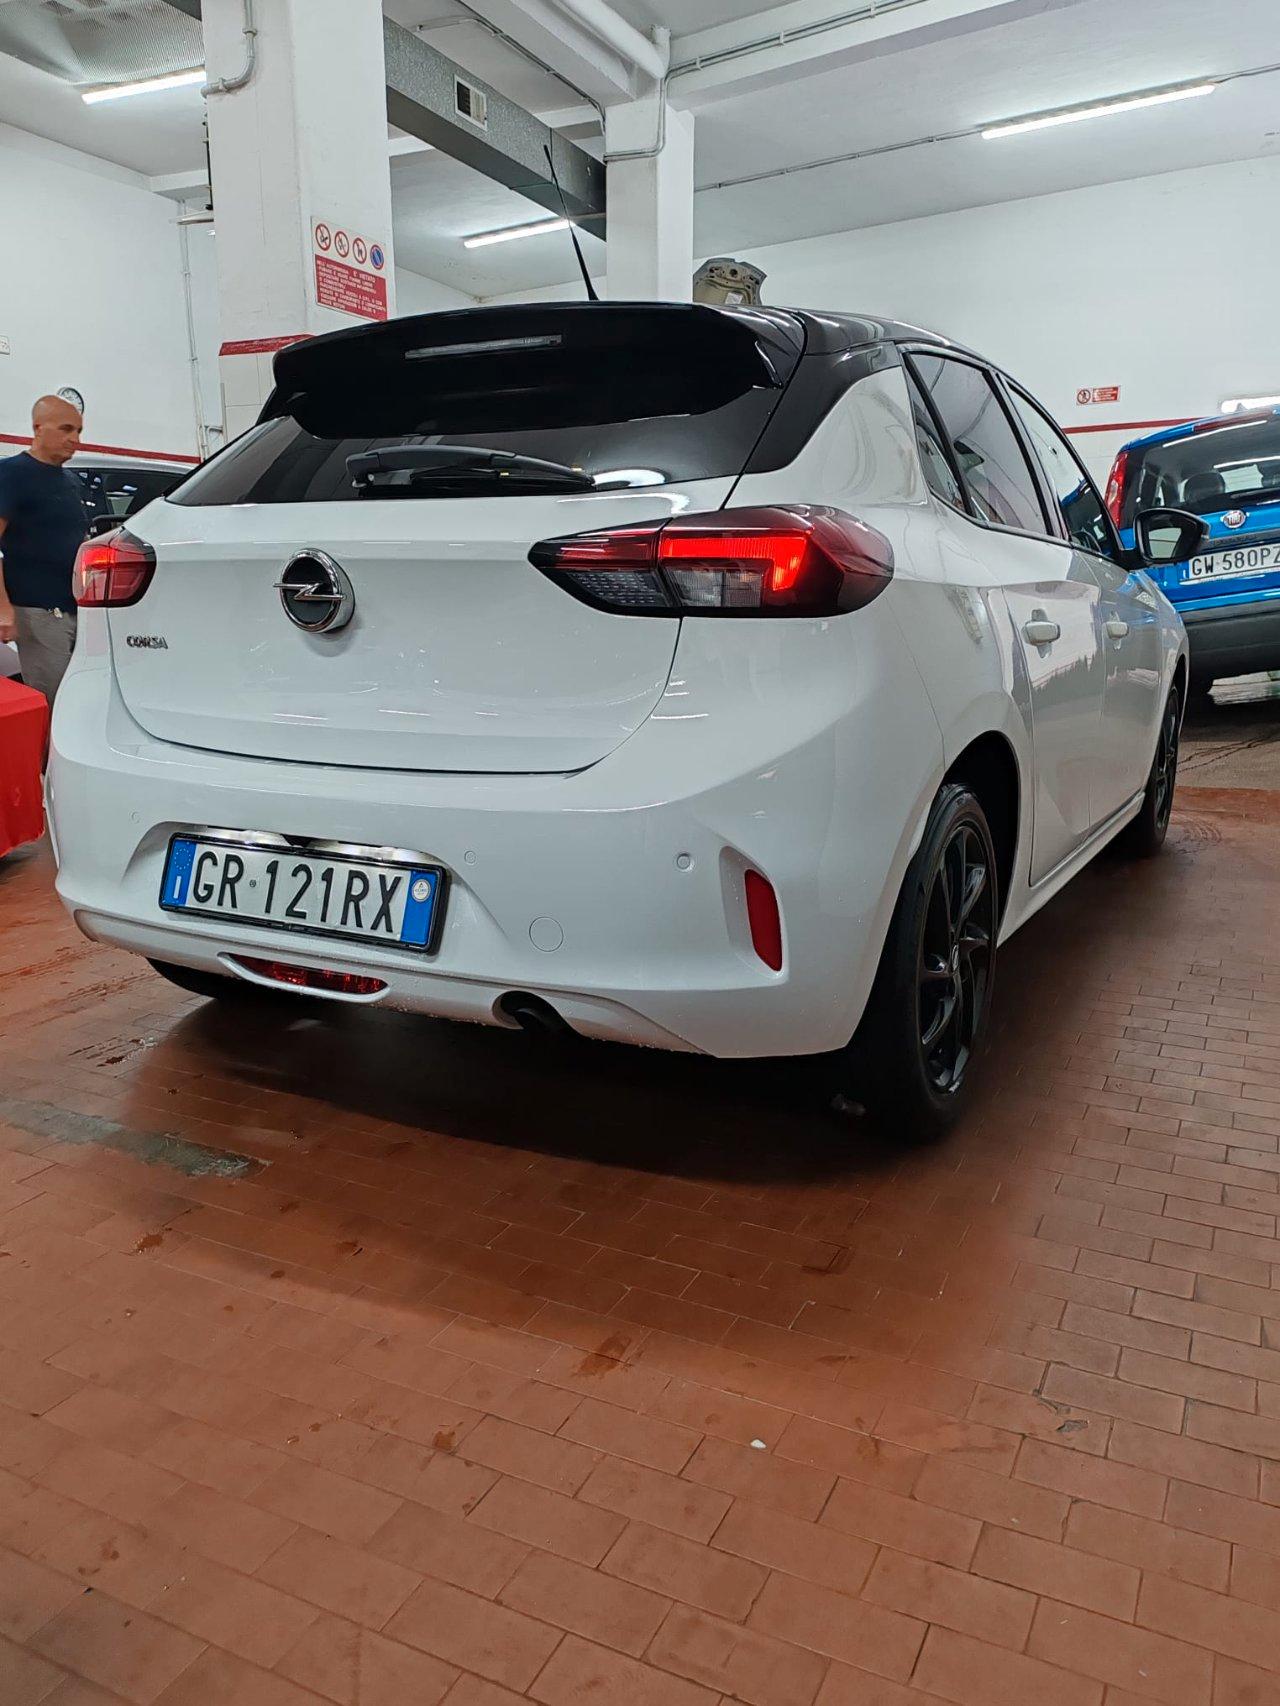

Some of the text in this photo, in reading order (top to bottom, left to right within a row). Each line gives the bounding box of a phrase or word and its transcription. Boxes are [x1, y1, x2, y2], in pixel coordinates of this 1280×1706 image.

[1191, 555, 1214, 576] GW
[1222, 545, 1280, 571] 580PZ
[193, 851, 245, 909] GR
[264, 860, 403, 933] 121RX
